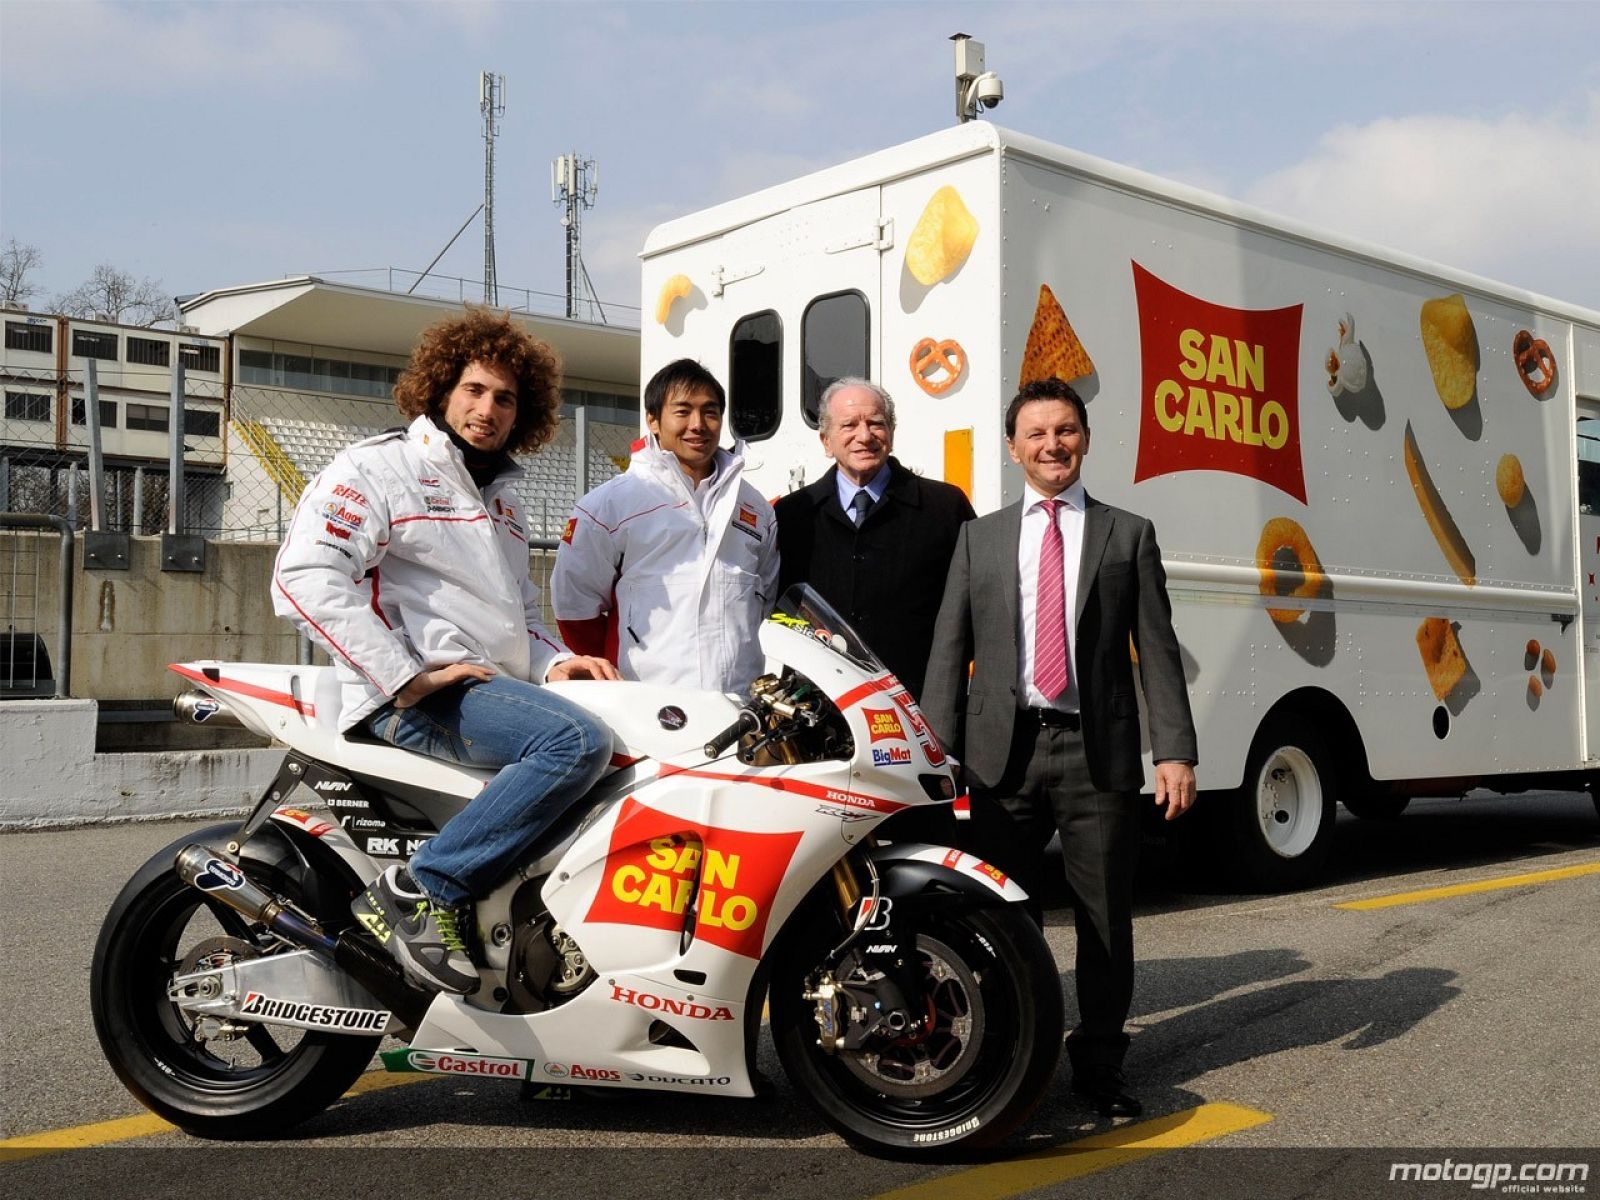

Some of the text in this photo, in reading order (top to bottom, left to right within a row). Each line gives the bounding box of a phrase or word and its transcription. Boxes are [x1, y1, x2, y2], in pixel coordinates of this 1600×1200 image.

[1178, 328, 1264, 392] SAN
[1154, 379, 1290, 450] CARLO
[335, 506, 362, 526] Agos
[873, 713, 894, 723] SAN
[870, 723, 902, 734] CARLO
[872, 747, 911, 764] BigMat
[336, 799, 370, 808] BERNER
[826, 790, 876, 808] HONDA
[356, 817, 386, 828] rizoma
[367, 837, 400, 852] RK
[645, 838, 741, 890] SAN
[243, 992, 389, 1031] BRIDGESTONE
[608, 985, 736, 1022] HONDA
[438, 1054, 520, 1077] Castrol
[570, 1064, 621, 1081] Agos
[648, 1075, 731, 1086] DUCATO
[913, 1116, 980, 1142] BRIDGESTONE
